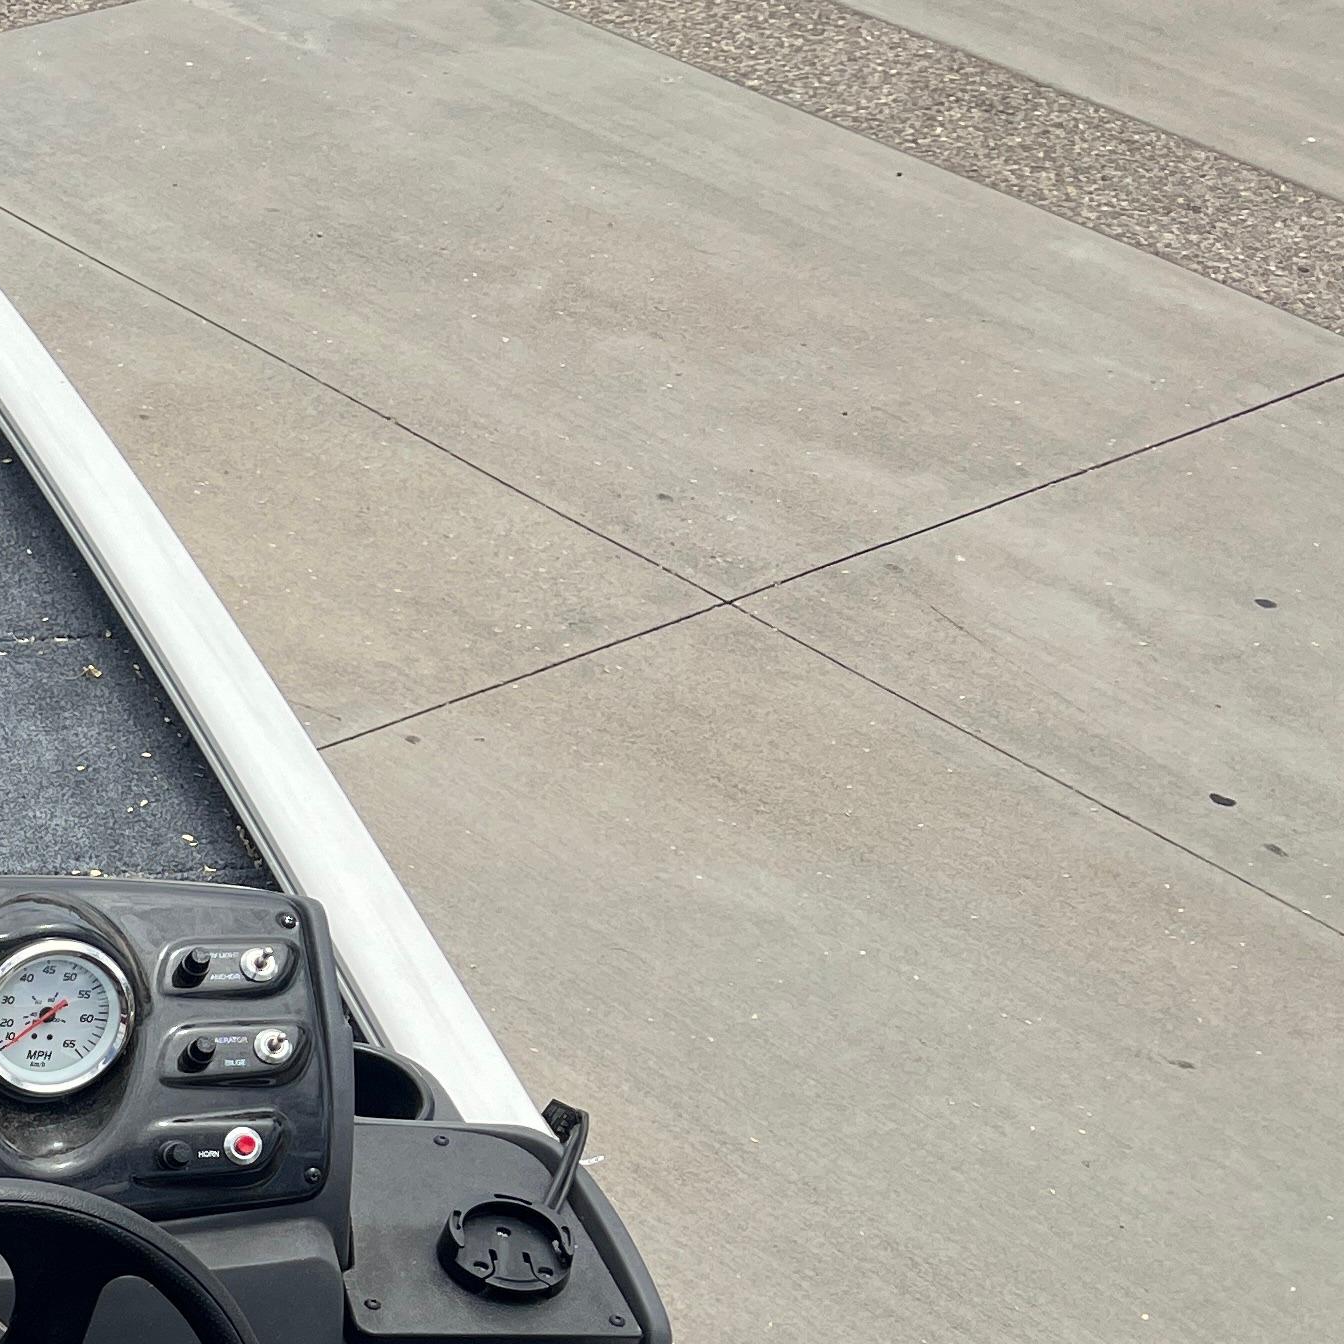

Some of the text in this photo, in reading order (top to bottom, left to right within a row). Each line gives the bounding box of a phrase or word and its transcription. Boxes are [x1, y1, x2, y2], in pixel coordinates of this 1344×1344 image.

[42, 965, 57, 975] 45
[19, 973, 35, 983] 40
[62, 972, 78, 982] 50
[77, 989, 92, 999] 55
[1, 995, 16, 1005] 30
[0, 1018, 14, 1028] 20
[79, 1014, 94, 1024] 60
[5, 1033, 16, 1041] 10
[62, 1039, 76, 1049] 65
[26, 1049, 53, 1061] MPH
[197, 1149, 220, 1158] HORN
